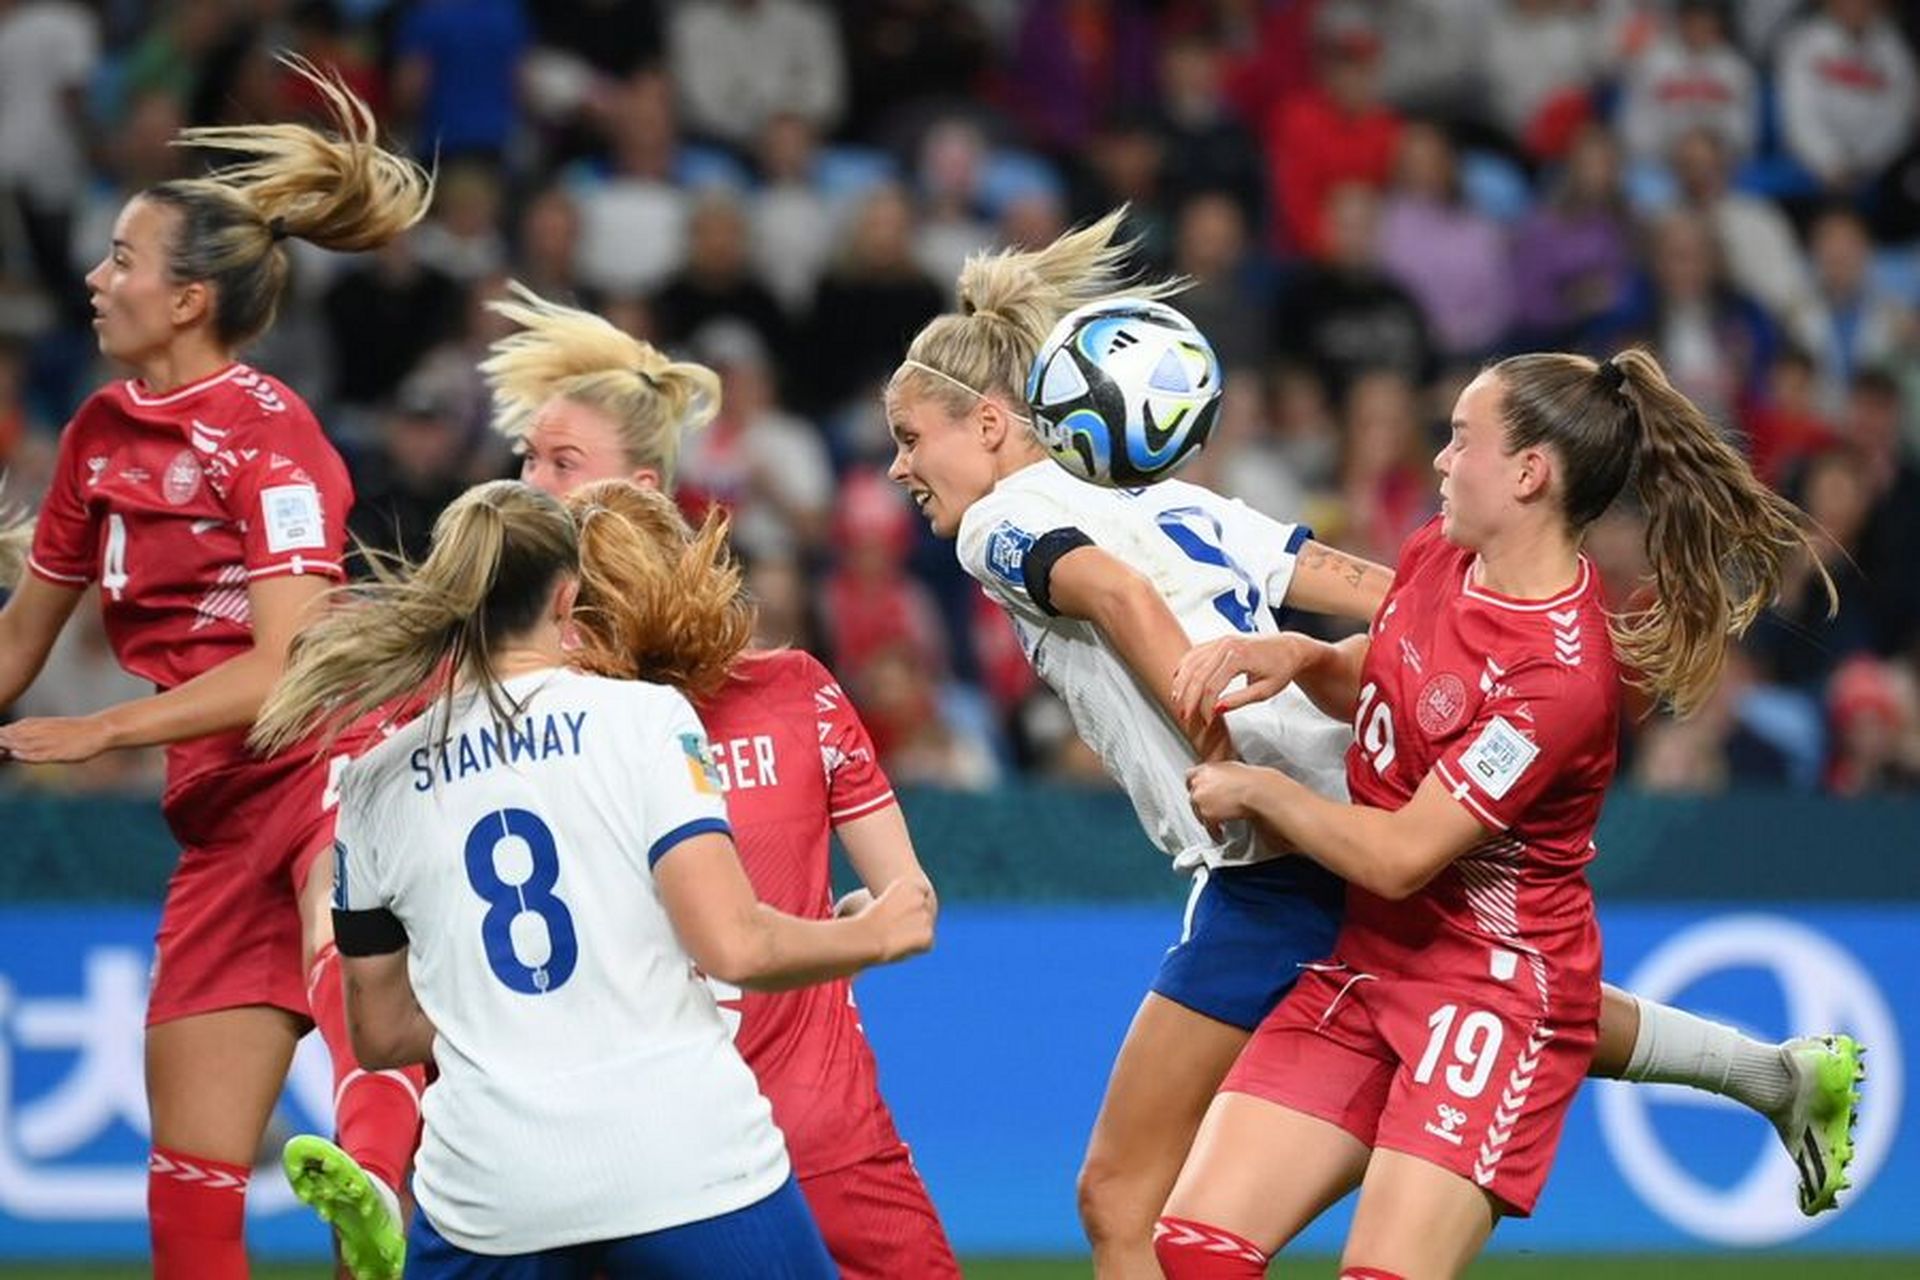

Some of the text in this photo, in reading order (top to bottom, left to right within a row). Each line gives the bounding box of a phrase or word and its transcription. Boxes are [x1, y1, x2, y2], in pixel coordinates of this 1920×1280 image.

[102, 513, 128, 601] 4
[1155, 506, 1261, 633] 9
[411, 711, 586, 791] STANWAY
[711, 735, 778, 792] GER
[1354, 682, 1395, 775] 19
[464, 808, 578, 995] 8
[1414, 1004, 1503, 1097] 19
